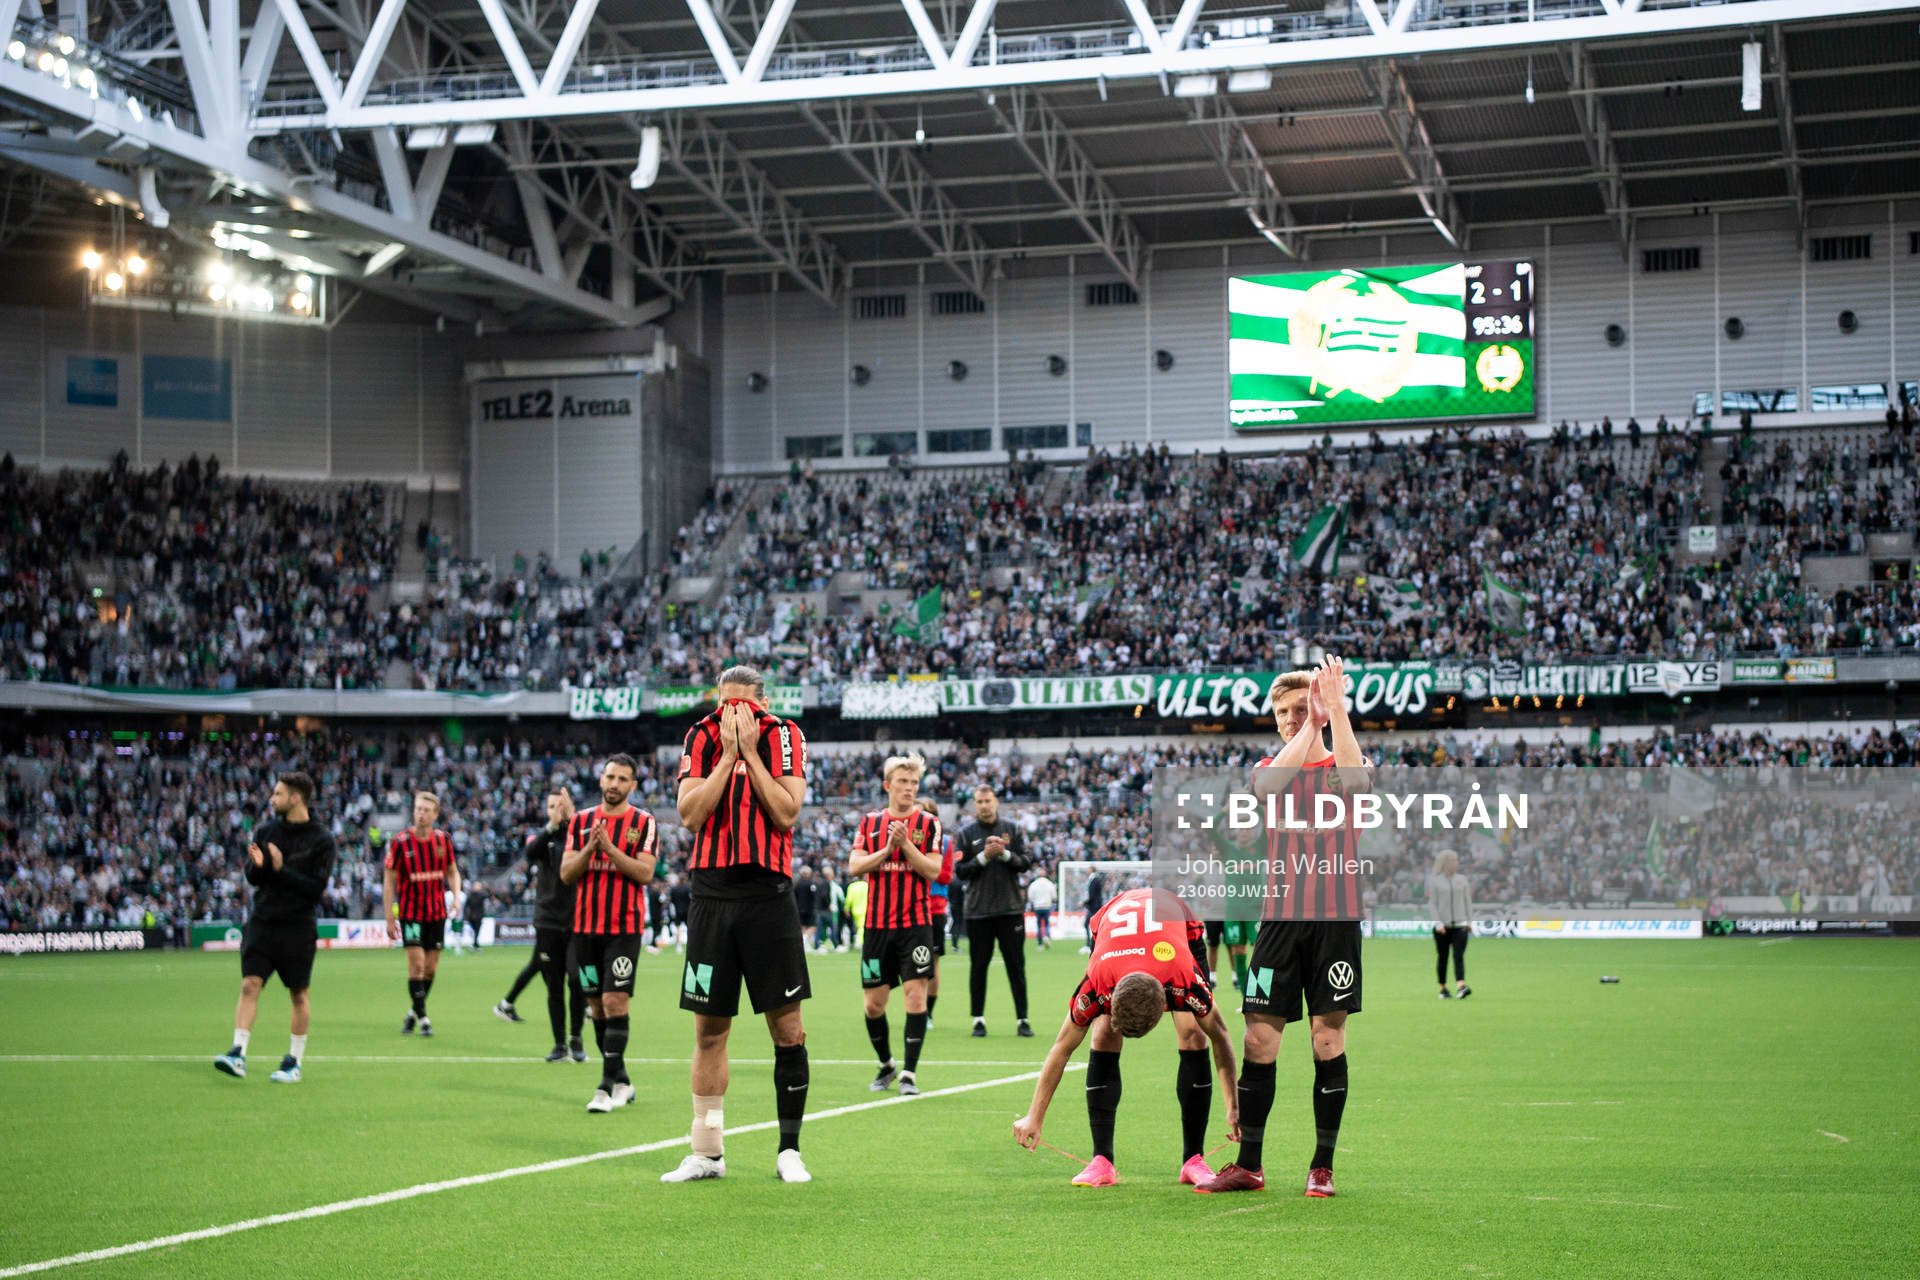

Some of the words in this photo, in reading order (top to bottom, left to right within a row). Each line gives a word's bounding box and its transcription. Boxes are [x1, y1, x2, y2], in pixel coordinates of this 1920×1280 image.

[1471, 281, 1486, 304] 2
[1510, 280, 1521, 301] 1
[1472, 314, 1523, 336] 95:36
[482, 388, 554, 420] TELE2
[559, 395, 631, 419] Arena
[1631, 664, 1658, 684] 12
[1683, 662, 1719, 683] YS
[1019, 676, 1146, 705] ULTRAS
[778, 725, 793, 770] stadium
[1108, 898, 1163, 938] 15
[1572, 917, 1594, 931] EL
[1599, 917, 1664, 931] LINJEN
[1668, 917, 1691, 931] AB
[1736, 916, 1818, 934] digipant.se
[45, 931, 93, 951] FASHION
[94, 931, 103, 950] &
[103, 930, 144, 950] SPORTS
[1101, 947, 1146, 961] Doorman
